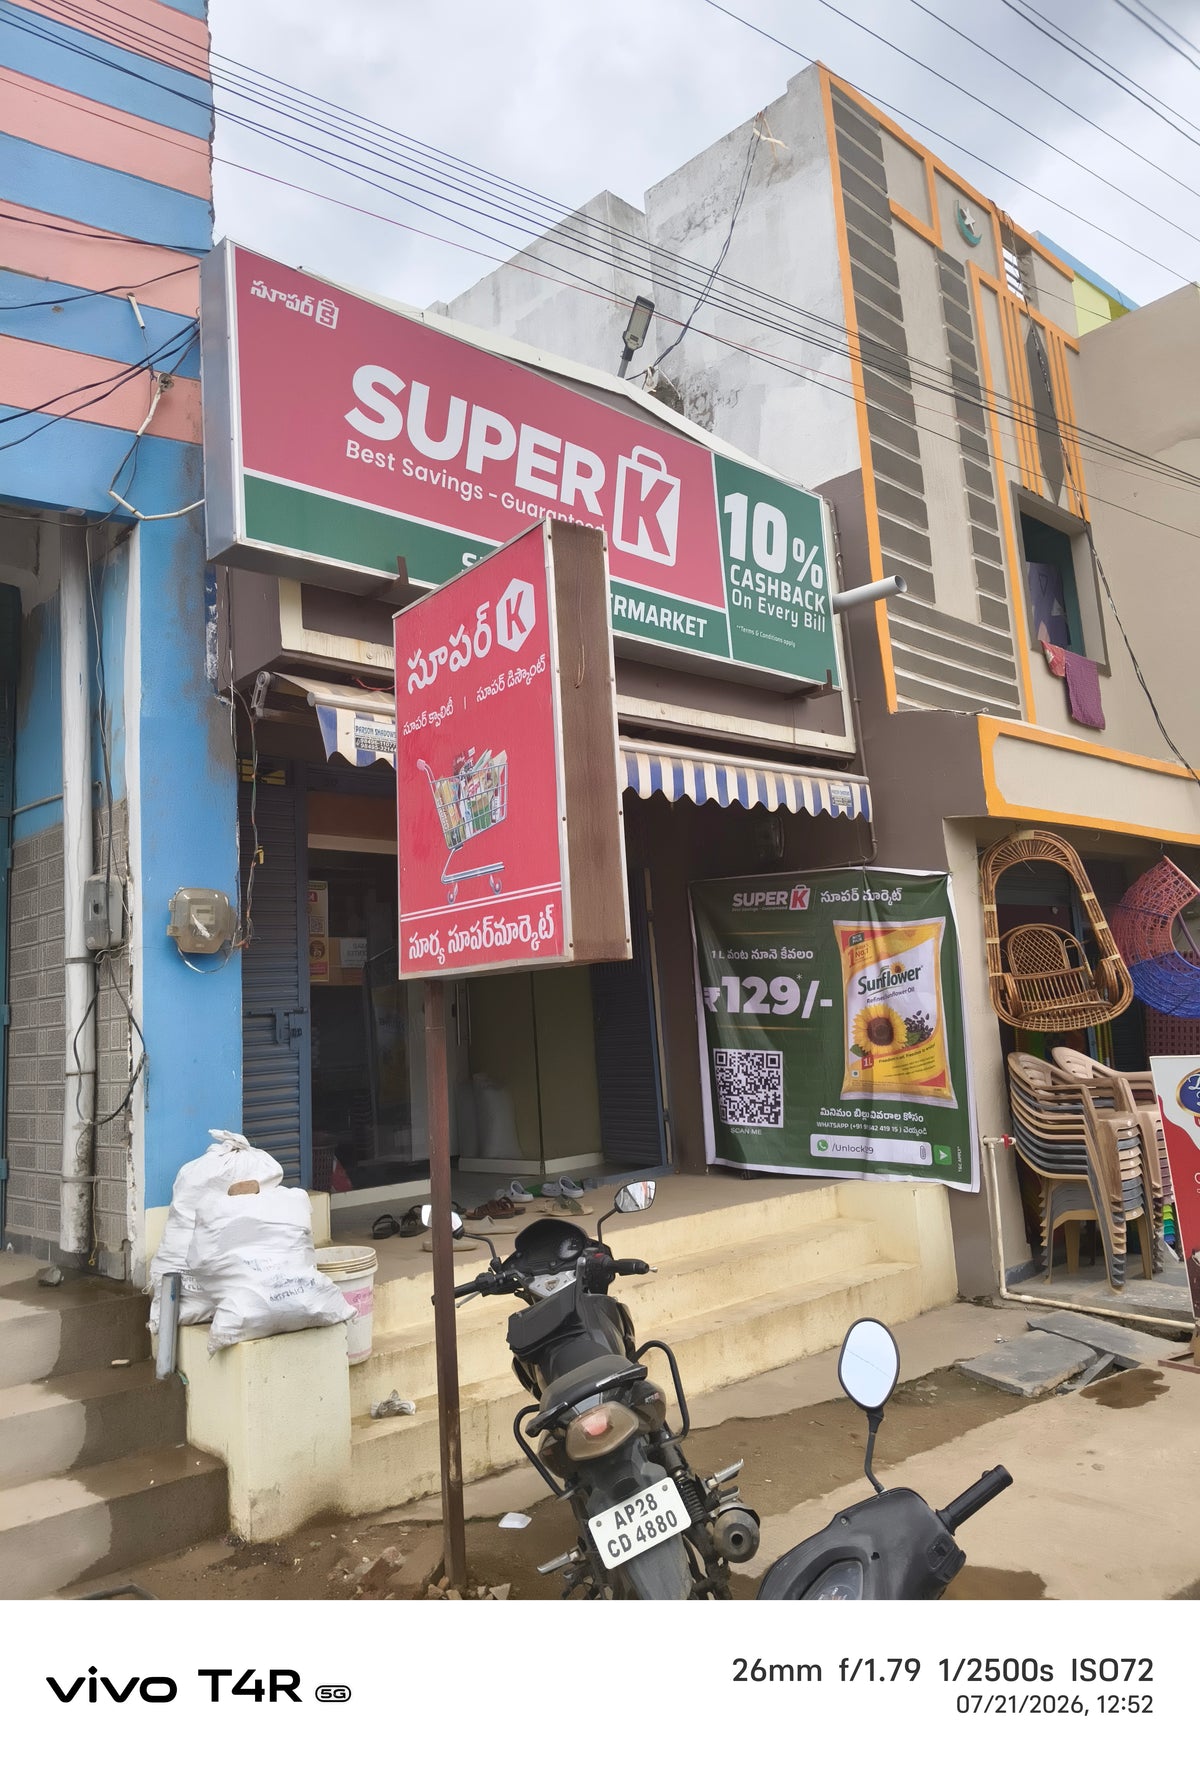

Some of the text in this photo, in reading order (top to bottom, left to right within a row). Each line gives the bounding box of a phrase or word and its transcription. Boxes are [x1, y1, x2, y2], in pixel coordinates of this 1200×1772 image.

[250, 279, 315, 317] సూపర్
[343, 364, 606, 517] SUPER
[346, 439, 395, 472] Best
[402, 457, 483, 501] Savings
[723, 492, 823, 590] 10%
[730, 564, 826, 615] CASHBACK
[732, 589, 826, 633] On Every Bill
[407, 601, 492, 695] సూపర్
[760, 631, 783, 643] Conditions
[403, 710, 428, 735] సూపర్
[476, 673, 505, 702] సూపర్
[732, 891, 788, 907] SUPER
[820, 887, 859, 903] సూపర్
[751, 948, 778, 960] నూనె
[780, 946, 814, 960] కేవలం
[857, 965, 921, 995] Sunflower
[816, 1121, 849, 1129] WHATSAPP
[614, 1492, 658, 1530] AP28
[607, 1509, 678, 1558] CD 4880
